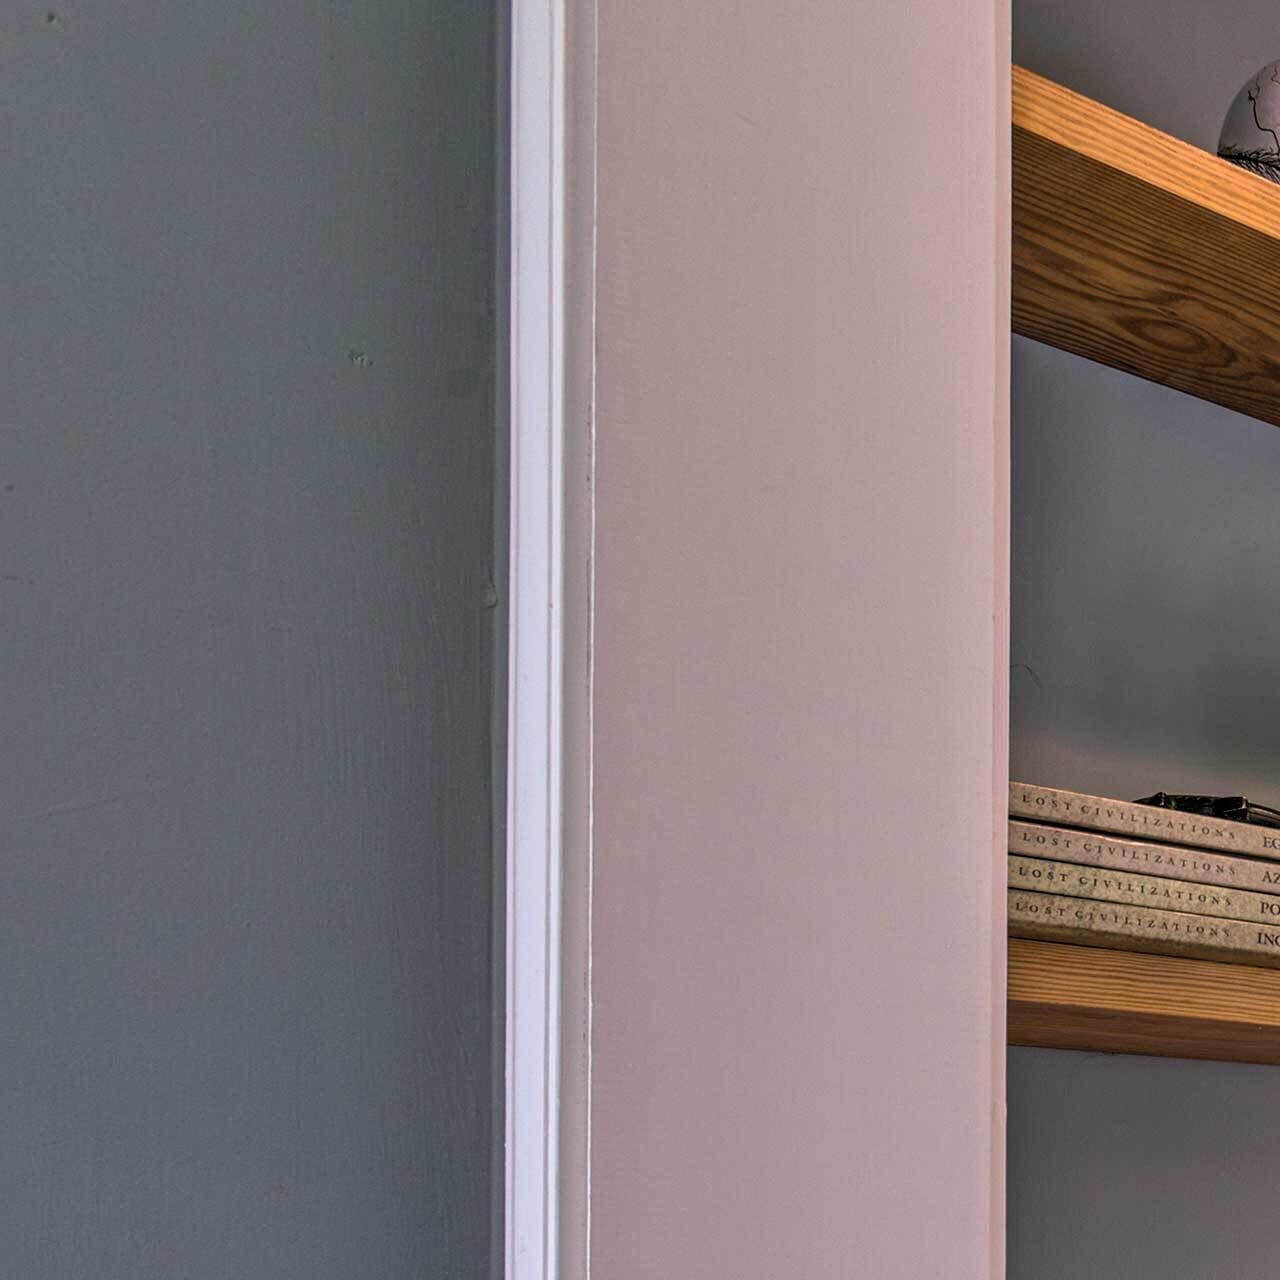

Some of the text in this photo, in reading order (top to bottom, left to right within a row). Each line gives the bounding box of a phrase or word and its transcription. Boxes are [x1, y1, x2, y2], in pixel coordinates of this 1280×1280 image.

[1022, 794, 1072, 810] LOST
[1081, 805, 1235, 839] CIVILIZATIONS
[1023, 832, 1072, 848] LOST
[1083, 843, 1236, 875] CIVILIZATIONS
[1019, 866, 1068, 881] LOST
[1079, 876, 1232, 906] CIVILIZATIONS
[1015, 902, 1066, 917] LOST
[1075, 910, 1232, 938] CIVILIZATIONS
